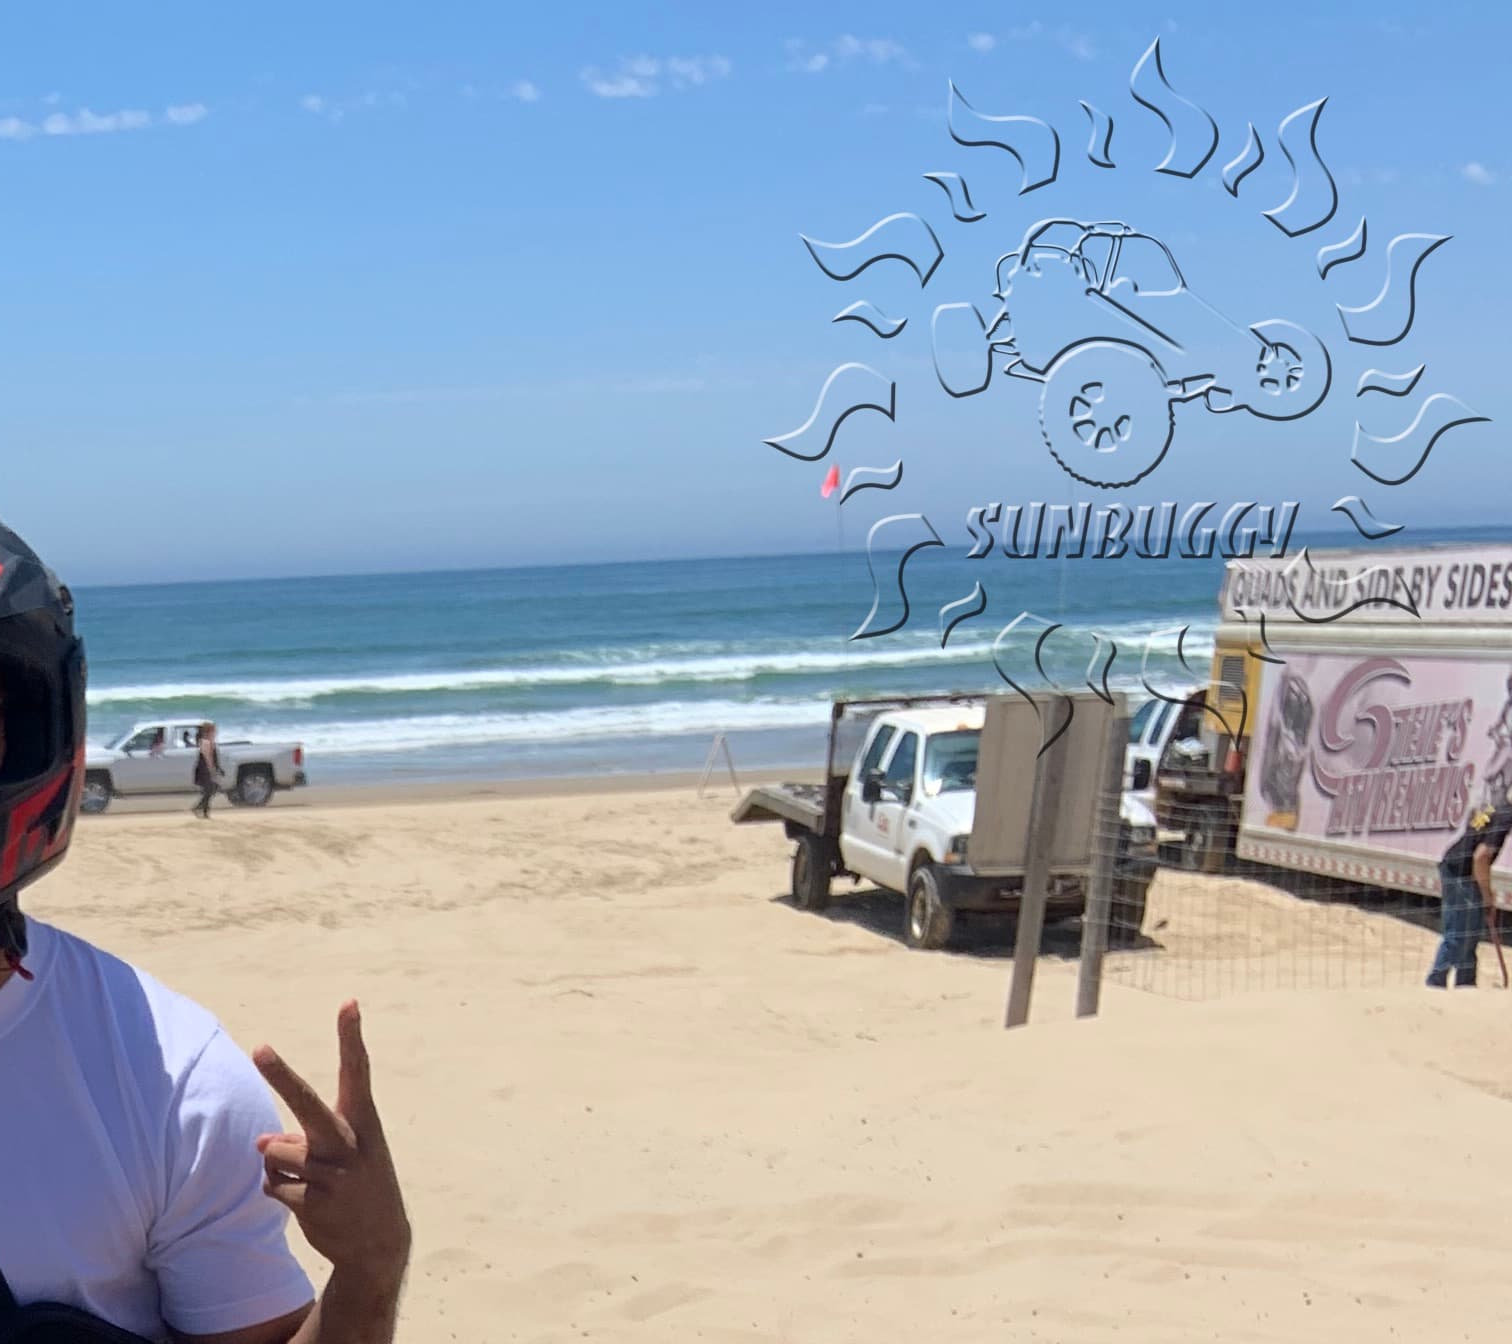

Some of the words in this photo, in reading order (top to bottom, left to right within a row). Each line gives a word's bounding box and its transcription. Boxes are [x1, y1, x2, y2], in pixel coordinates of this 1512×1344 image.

[1301, 567, 1349, 608] AND
[1355, 566, 1411, 608] SIDE
[1411, 564, 1442, 608] BY
